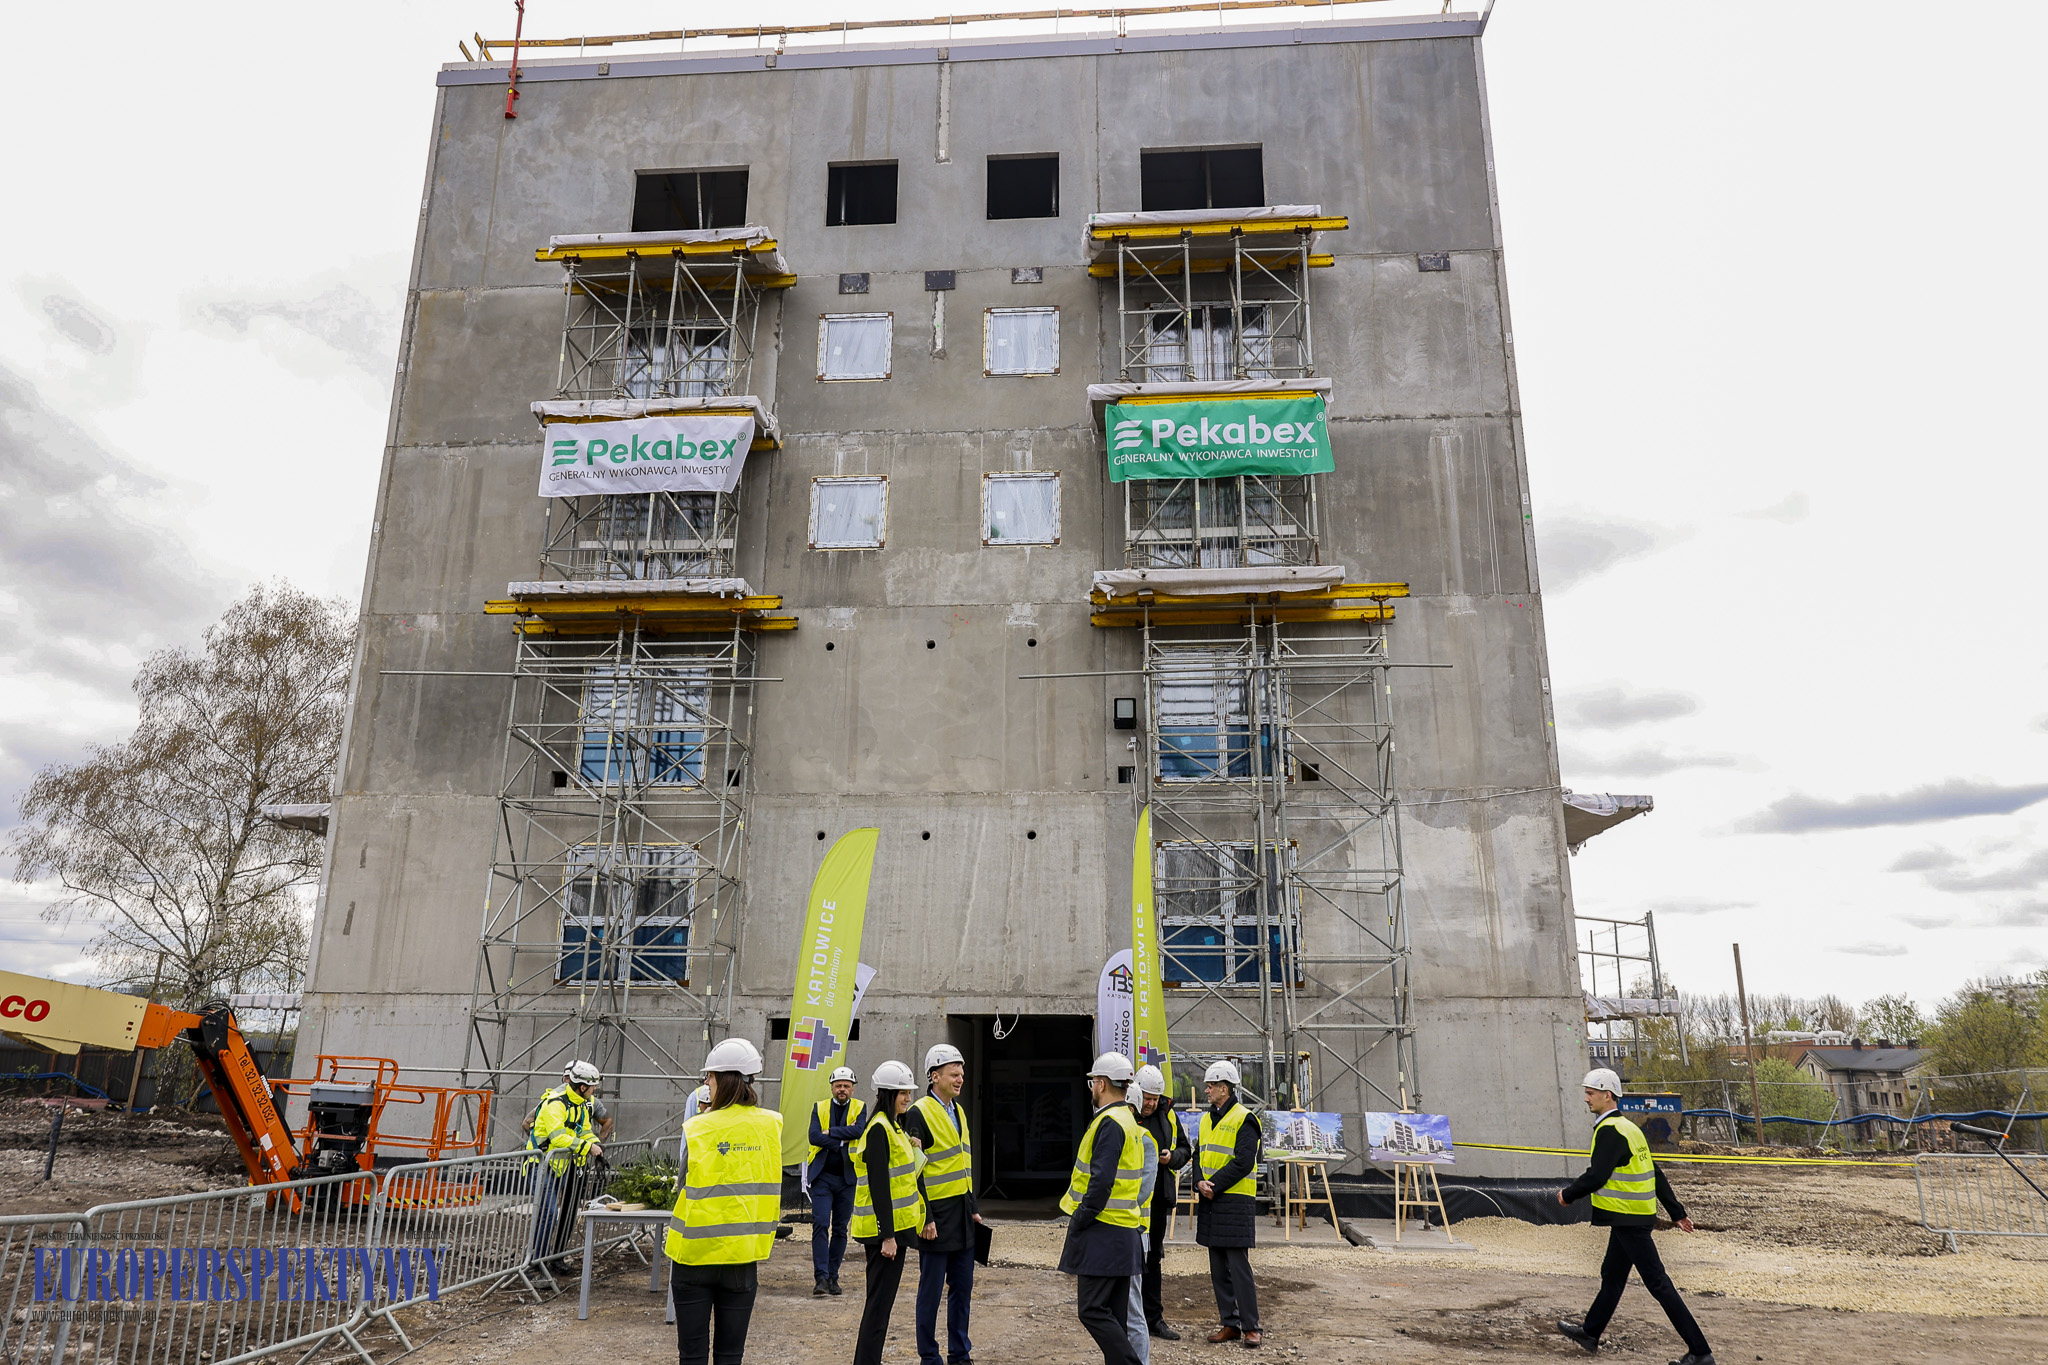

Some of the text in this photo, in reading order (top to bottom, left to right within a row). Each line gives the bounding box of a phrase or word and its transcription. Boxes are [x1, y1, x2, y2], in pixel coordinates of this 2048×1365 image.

[1113, 448, 1318, 466] GENERALNY WYKONAWCA INWESTYCJI
[549, 469, 606, 482] GENERALNY
[609, 466, 678, 478] WYKONAWCA
[806, 898, 837, 1006] KATOWICE
[1136, 902, 1148, 1018] KATOWICE
[825, 946, 844, 1008] dla odmiany
[238, 1052, 249, 1071] Tel.
[245, 1069, 257, 1082] 32
[252, 1083, 263, 1096] 32
[260, 1074, 274, 1099] mateco
[257, 1094, 269, 1108] 32
[261, 1105, 275, 1123] 032
